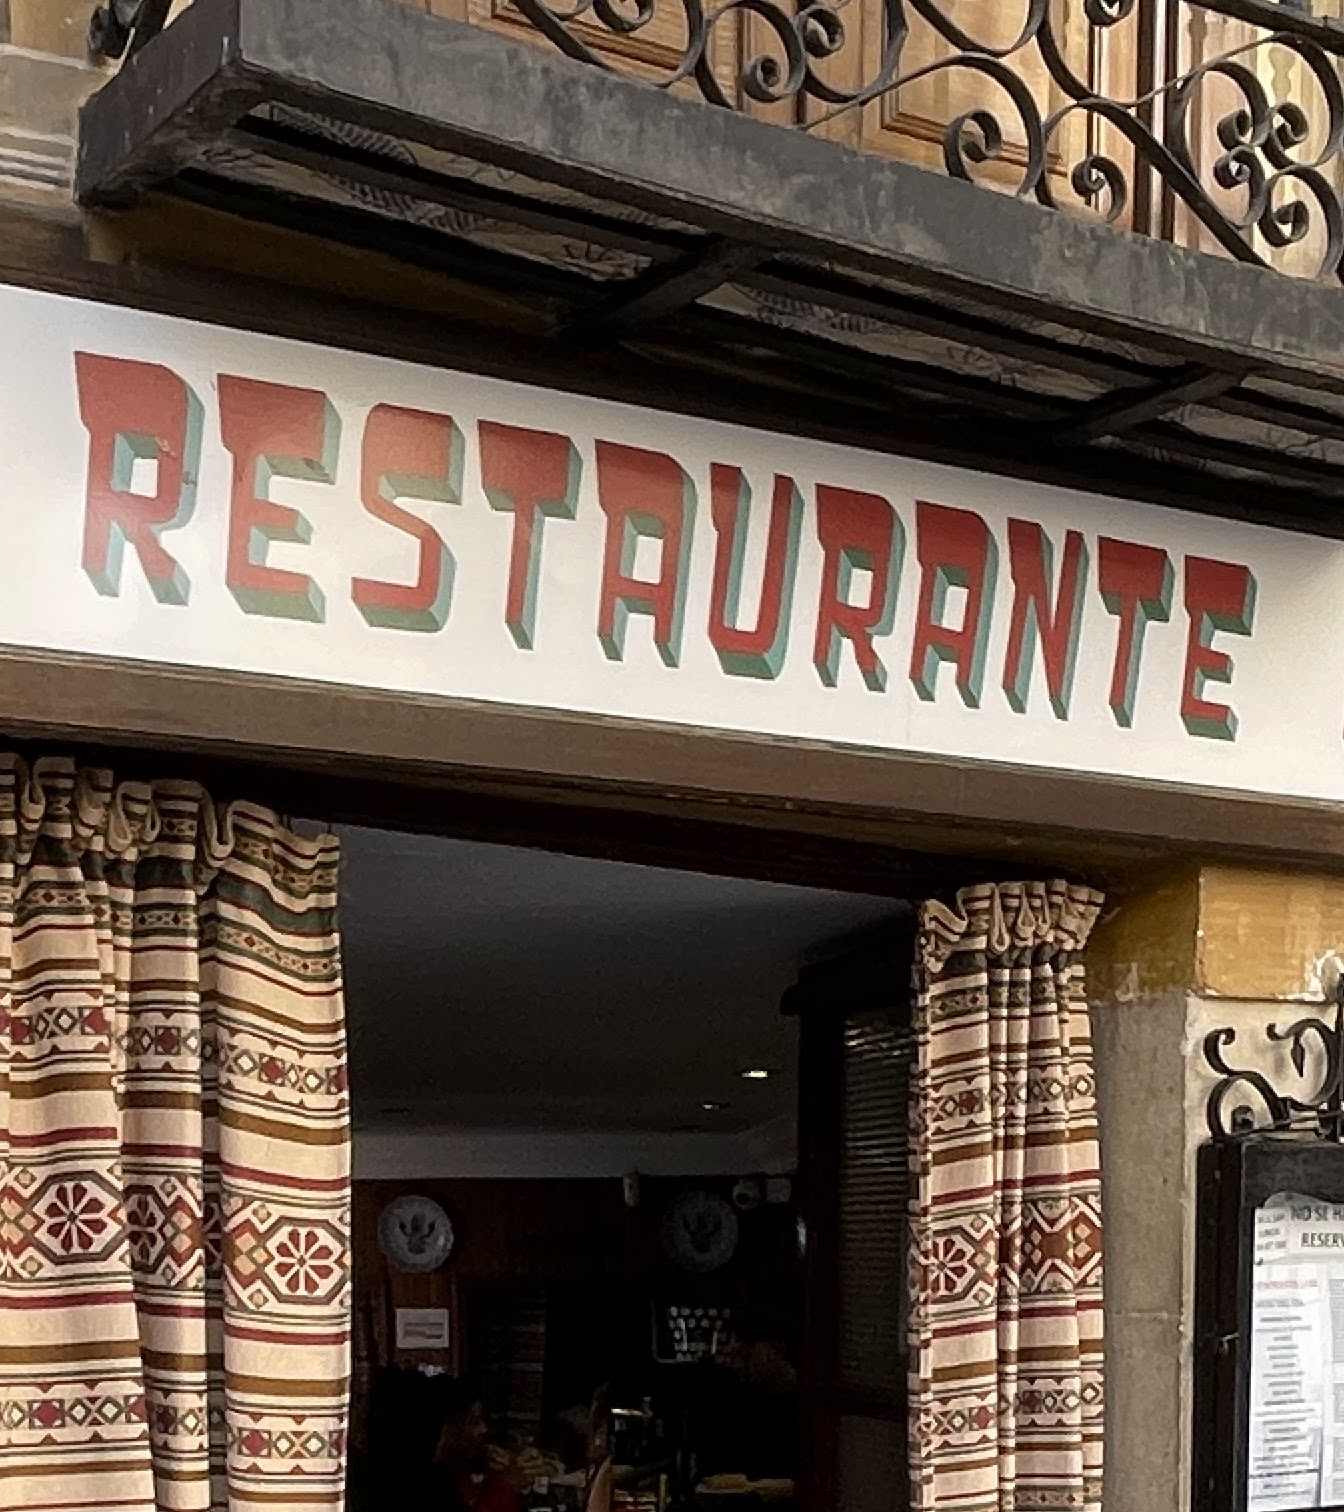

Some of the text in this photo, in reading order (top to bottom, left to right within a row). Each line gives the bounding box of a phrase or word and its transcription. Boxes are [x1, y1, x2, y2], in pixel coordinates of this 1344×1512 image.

[74, 349, 1258, 741] RESTAURANTE
[1289, 1206, 1310, 1222] NO
[1312, 1206, 1329, 1222] SE
